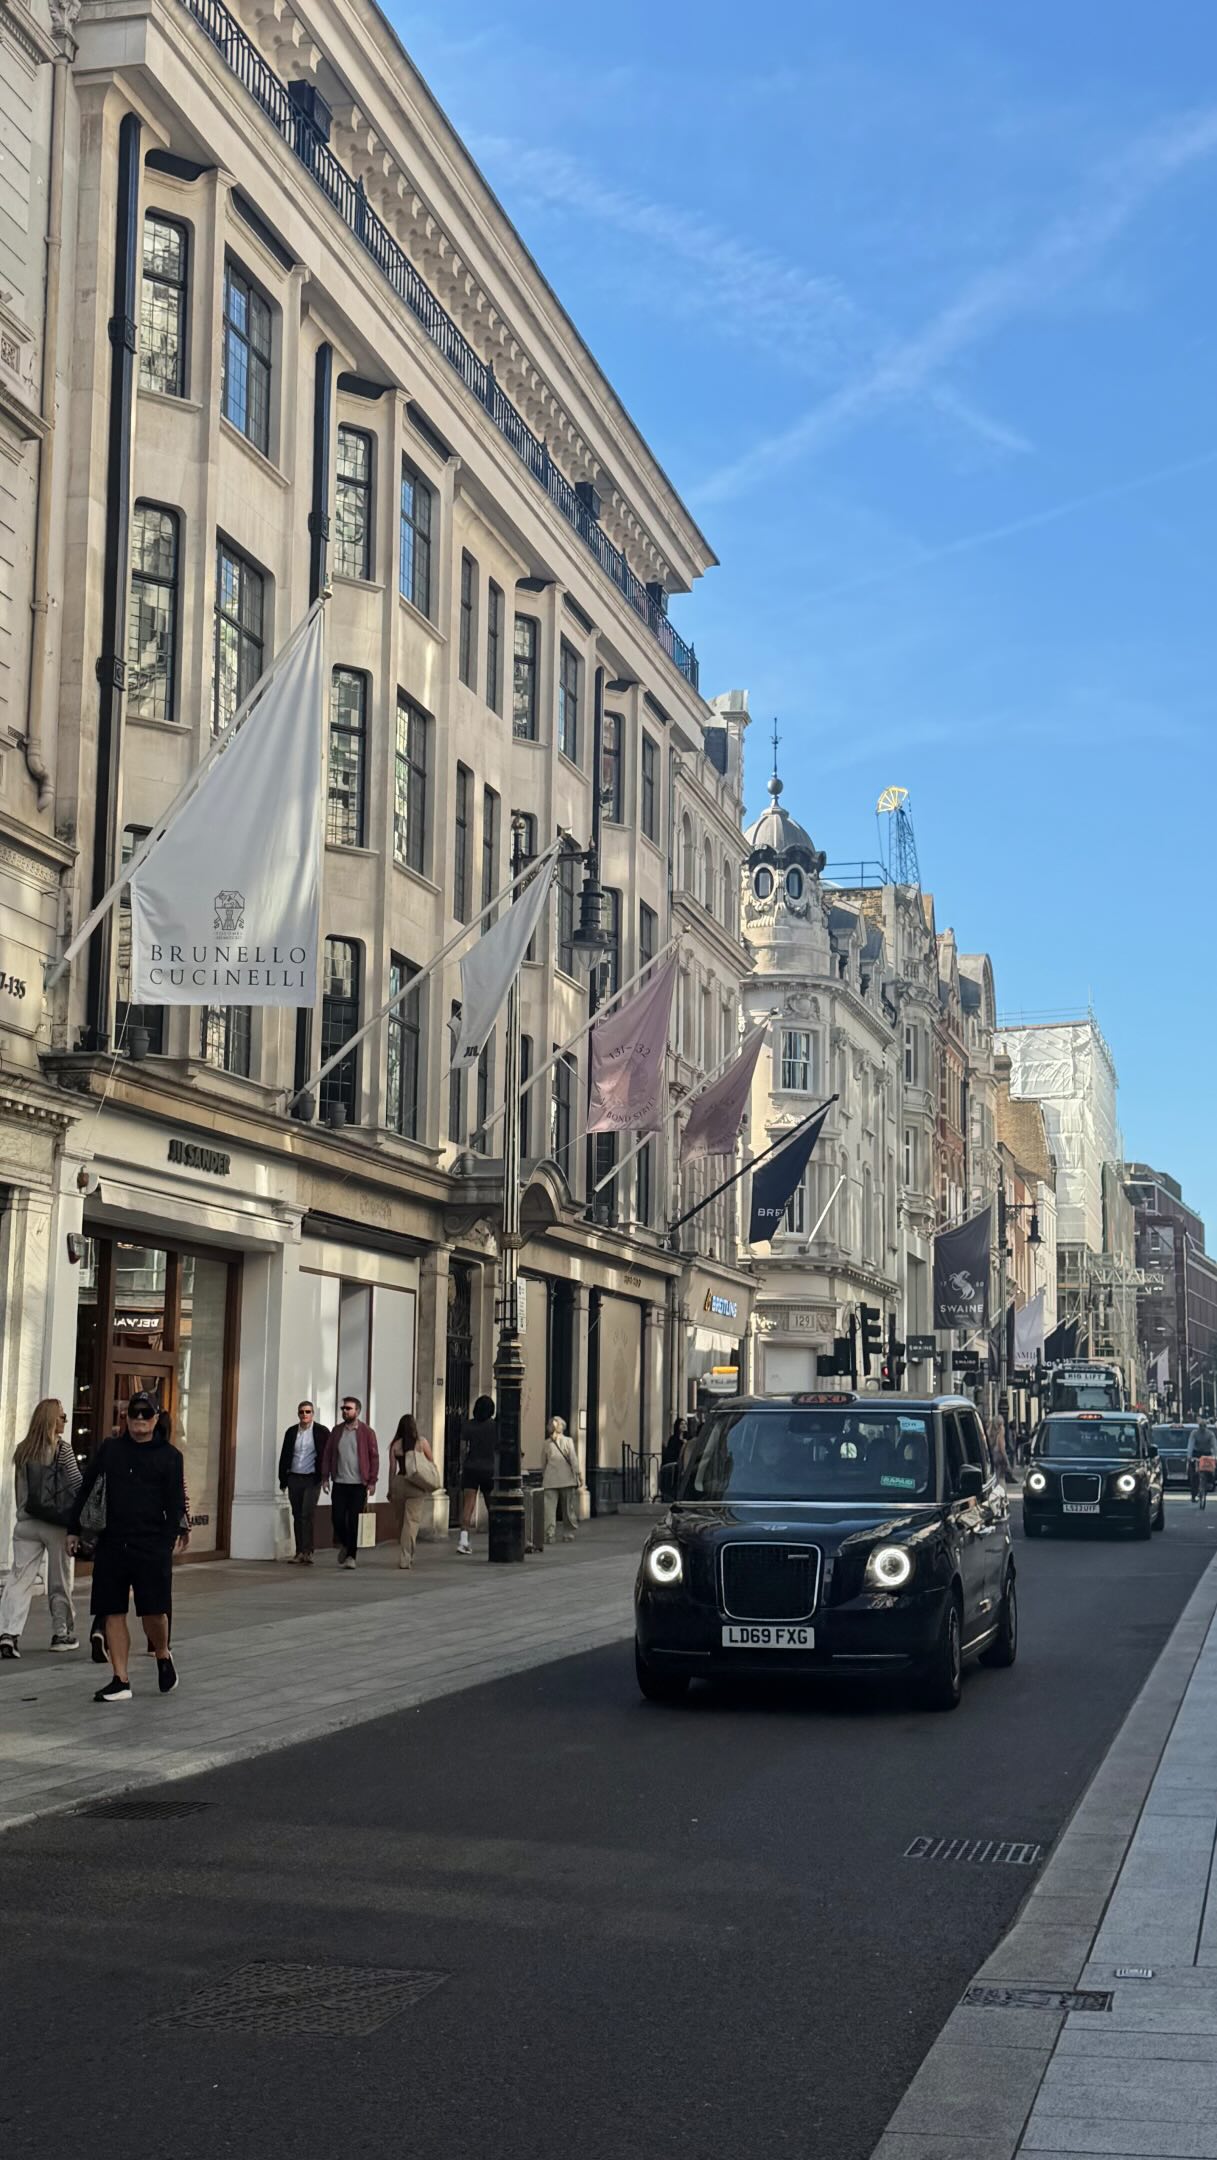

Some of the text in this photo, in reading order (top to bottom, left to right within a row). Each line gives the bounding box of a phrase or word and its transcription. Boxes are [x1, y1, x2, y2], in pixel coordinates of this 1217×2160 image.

[151, 944, 306, 963] BRUNELLO
[150, 968, 305, 987] CUCINELLI
[184, 1143, 231, 1177] SANDER
[940, 1304, 984, 1313] SWAINE
[795, 1316, 811, 1328] 129
[191, 1514, 209, 1526] ANDER
[729, 1627, 808, 1645] LD69 FXG
